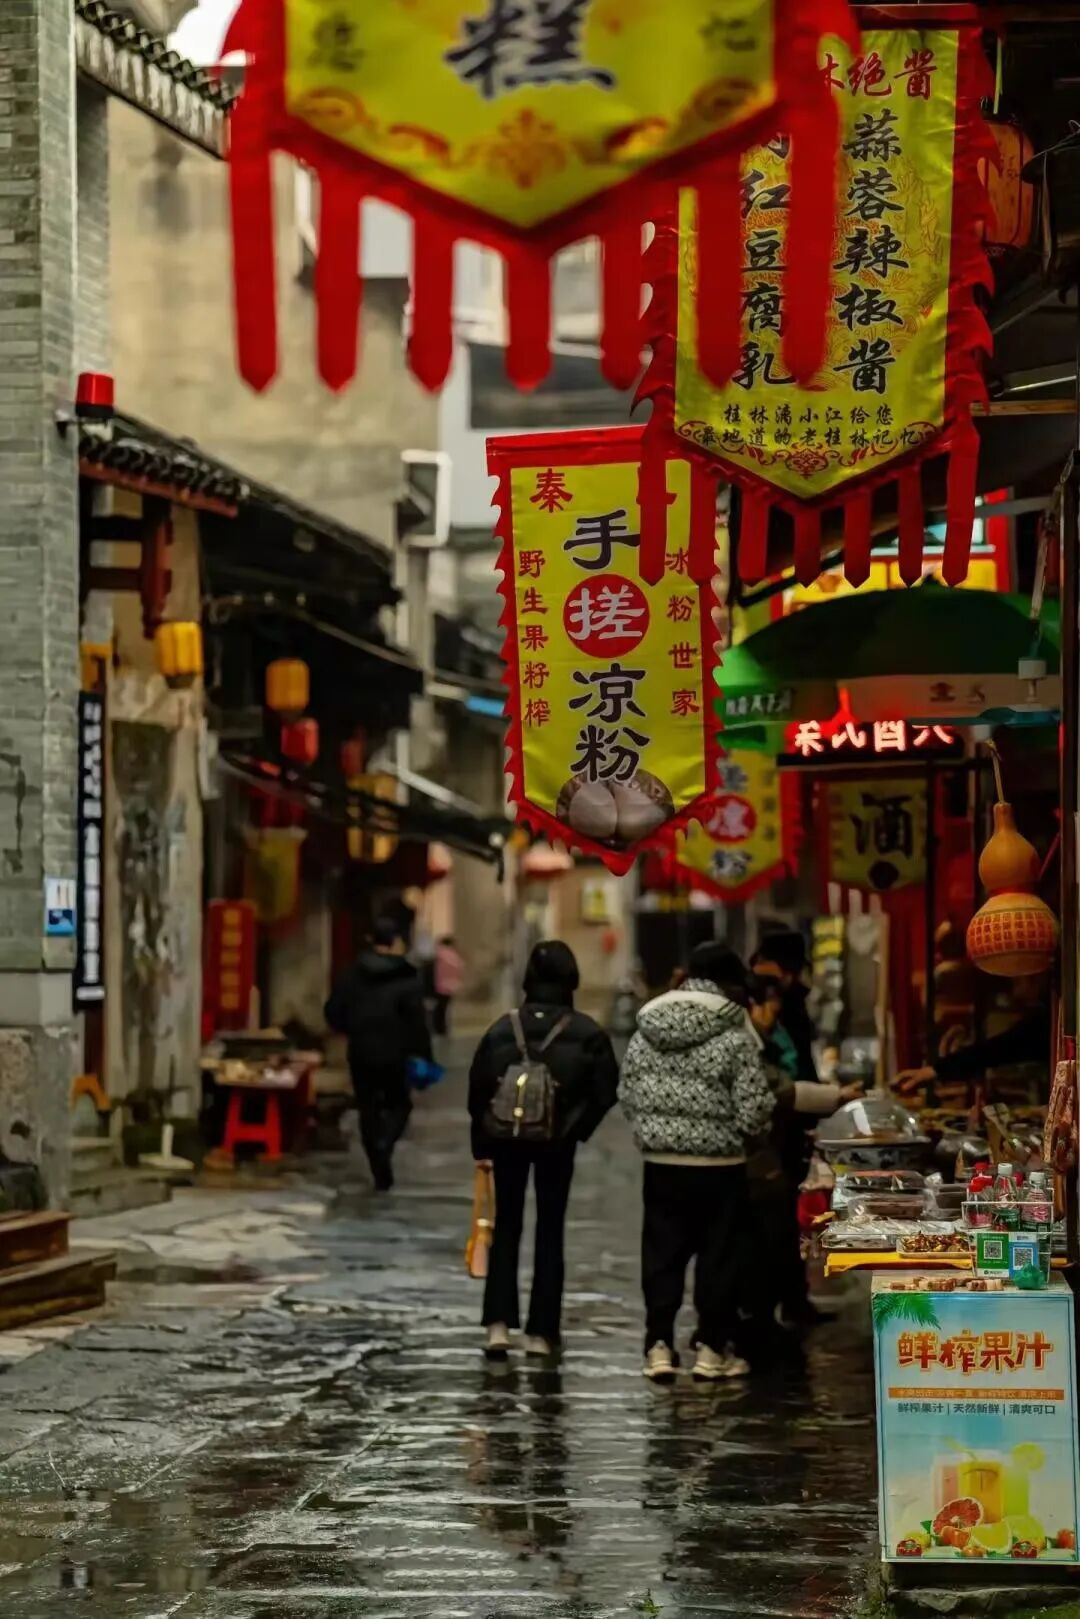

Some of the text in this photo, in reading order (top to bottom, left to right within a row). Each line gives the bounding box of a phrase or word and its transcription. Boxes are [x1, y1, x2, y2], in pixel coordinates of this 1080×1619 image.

[732, 133, 797, 390] 红豆腐乳
[702, 427, 920, 447] 最地道的老桂林记忆
[724, 403, 893, 425] 桂林漓小江给您
[563, 510, 651, 782] 手搓凉粉
[664, 547, 700, 716] 冰粉世家
[897, 1328, 1054, 1377] 鲜榨果汁
[897, 1402, 1056, 1415] 鲜榨果汁 天然新鲜 清爽可口
